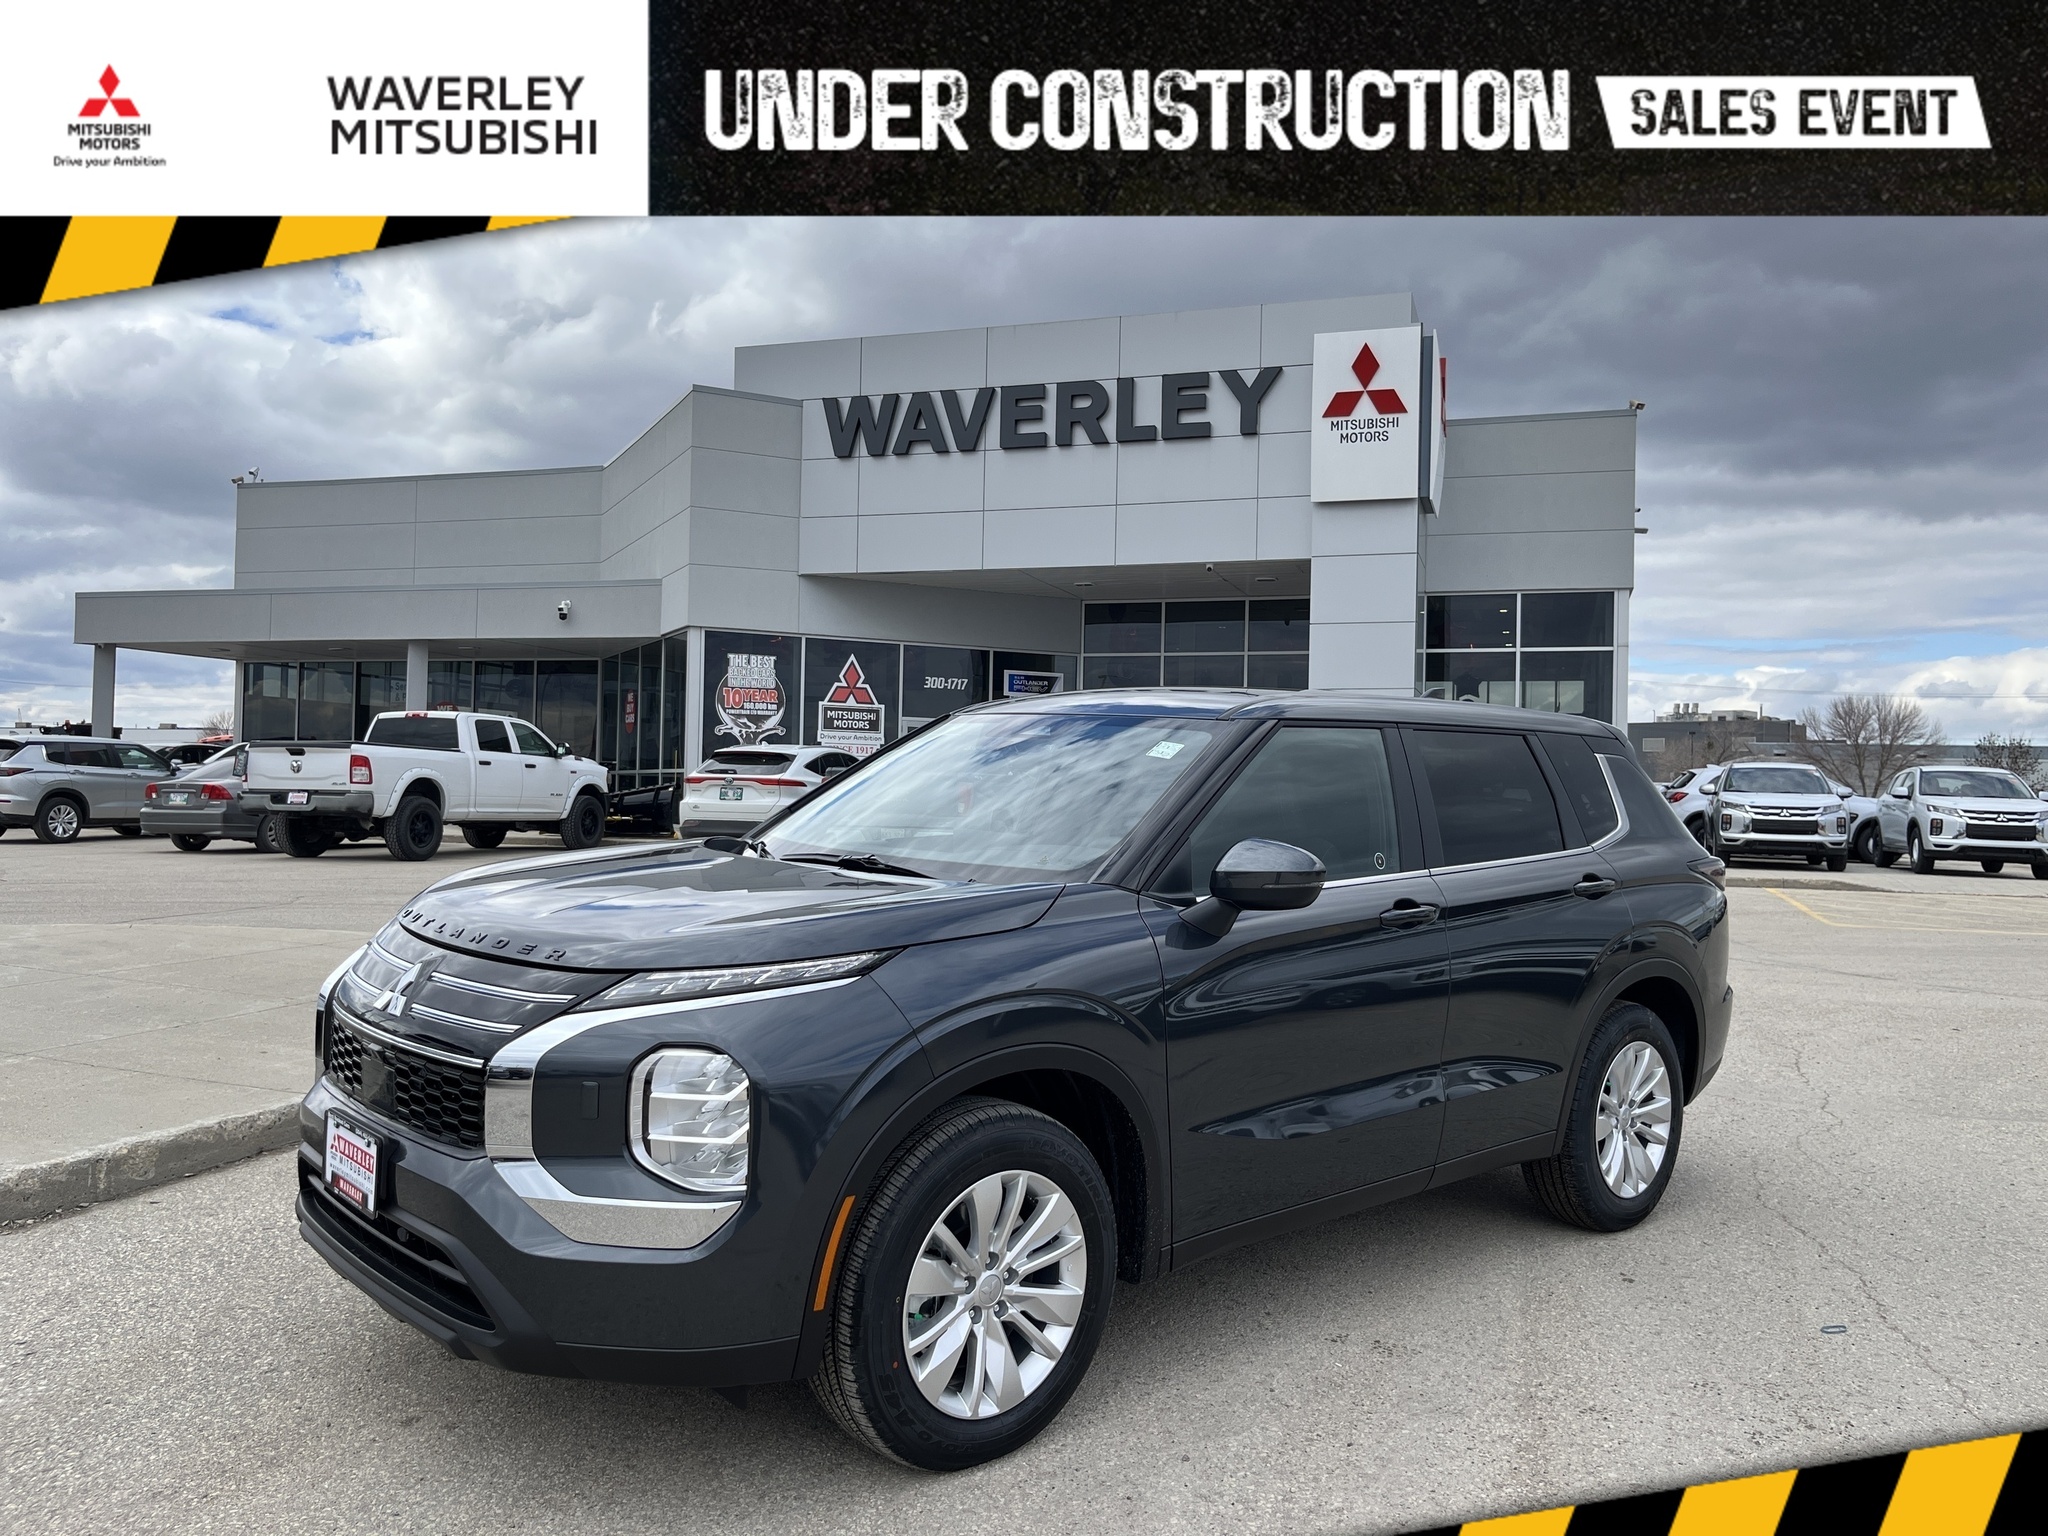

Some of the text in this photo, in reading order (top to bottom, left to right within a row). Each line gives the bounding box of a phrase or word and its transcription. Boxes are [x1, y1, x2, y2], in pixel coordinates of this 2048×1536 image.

[822, 366, 1284, 458] WAVERLEY
[1330, 417, 1400, 431] MITSUBISHI
[1340, 431, 1389, 444] MOTORS
[728, 653, 777, 668] THE BEST
[923, 676, 968, 690] 300-1717
[723, 687, 779, 708] 10 YEAR
[827, 710, 877, 721] MITSUBISHI
[833, 719, 870, 729] MOTORS
[853, 734, 882, 742] Ambition
[856, 746, 874, 755] 1917
[401, 908, 567, 962] OUTLANDER
[339, 1137, 375, 1173] WAVERLEY
